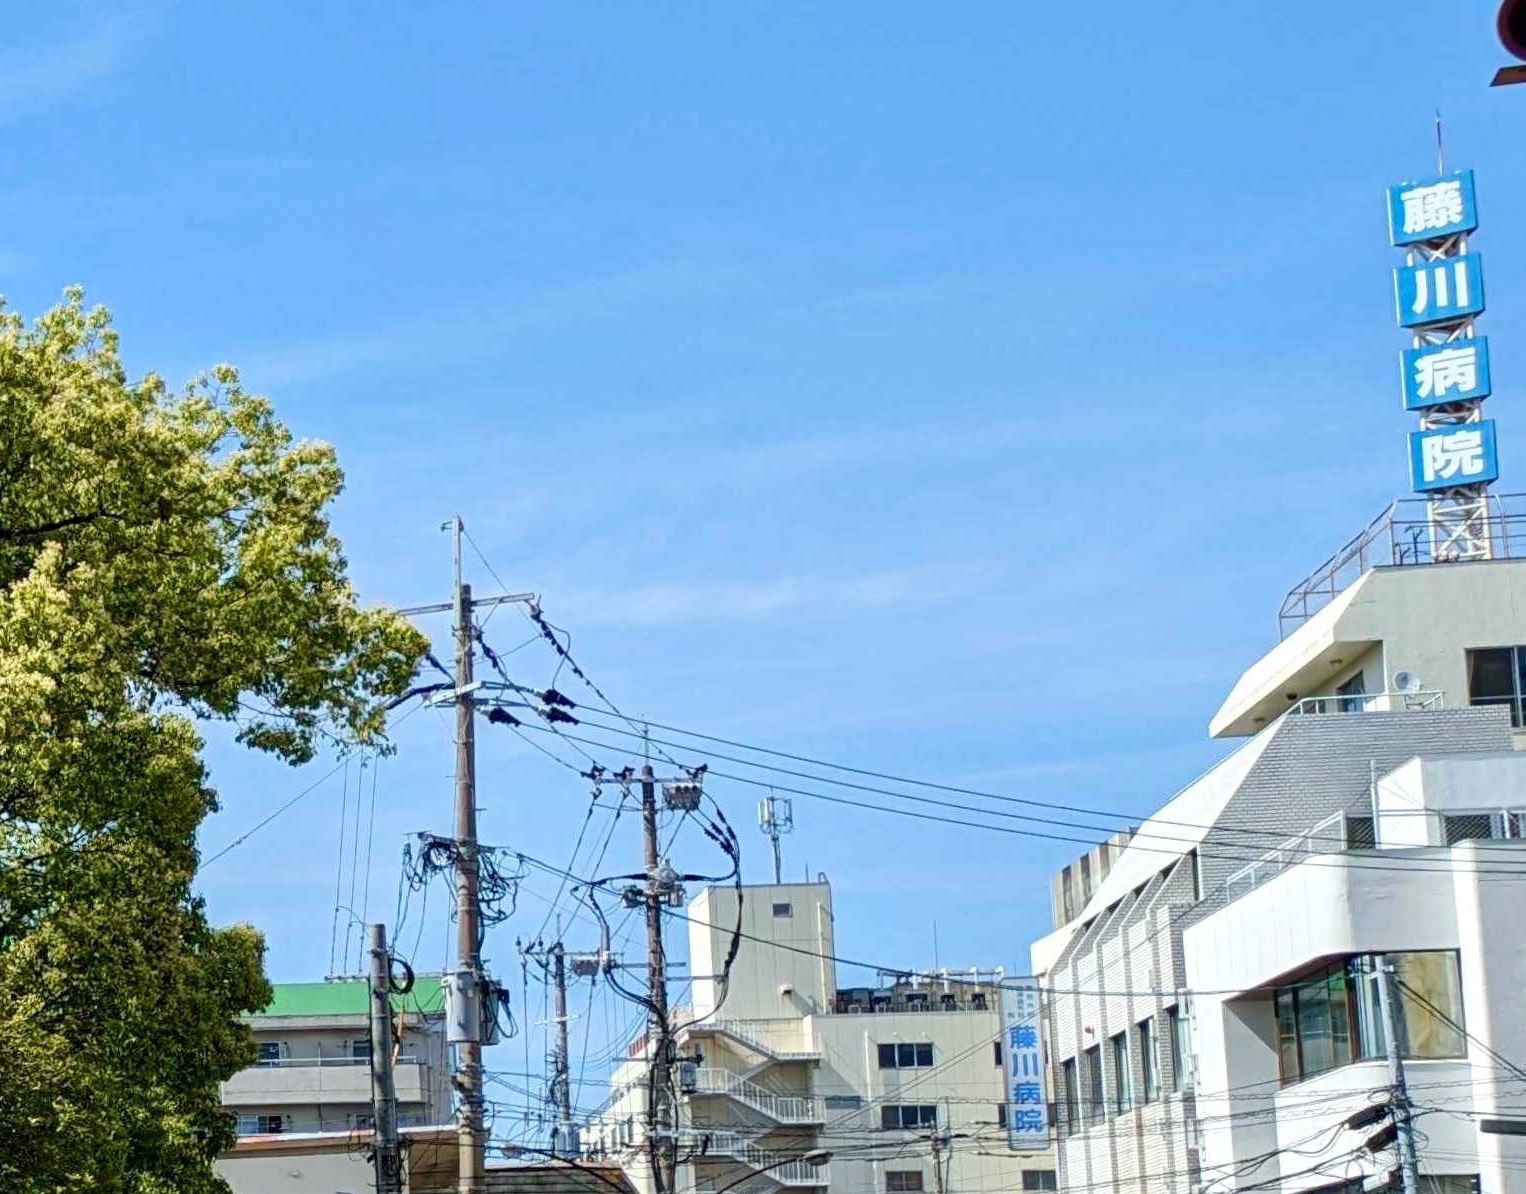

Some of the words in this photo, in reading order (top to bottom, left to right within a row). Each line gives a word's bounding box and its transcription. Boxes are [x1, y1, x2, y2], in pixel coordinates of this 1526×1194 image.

[1401, 180, 1484, 482] 藤川病院
[1009, 1025, 1044, 1133] 藤川病院
